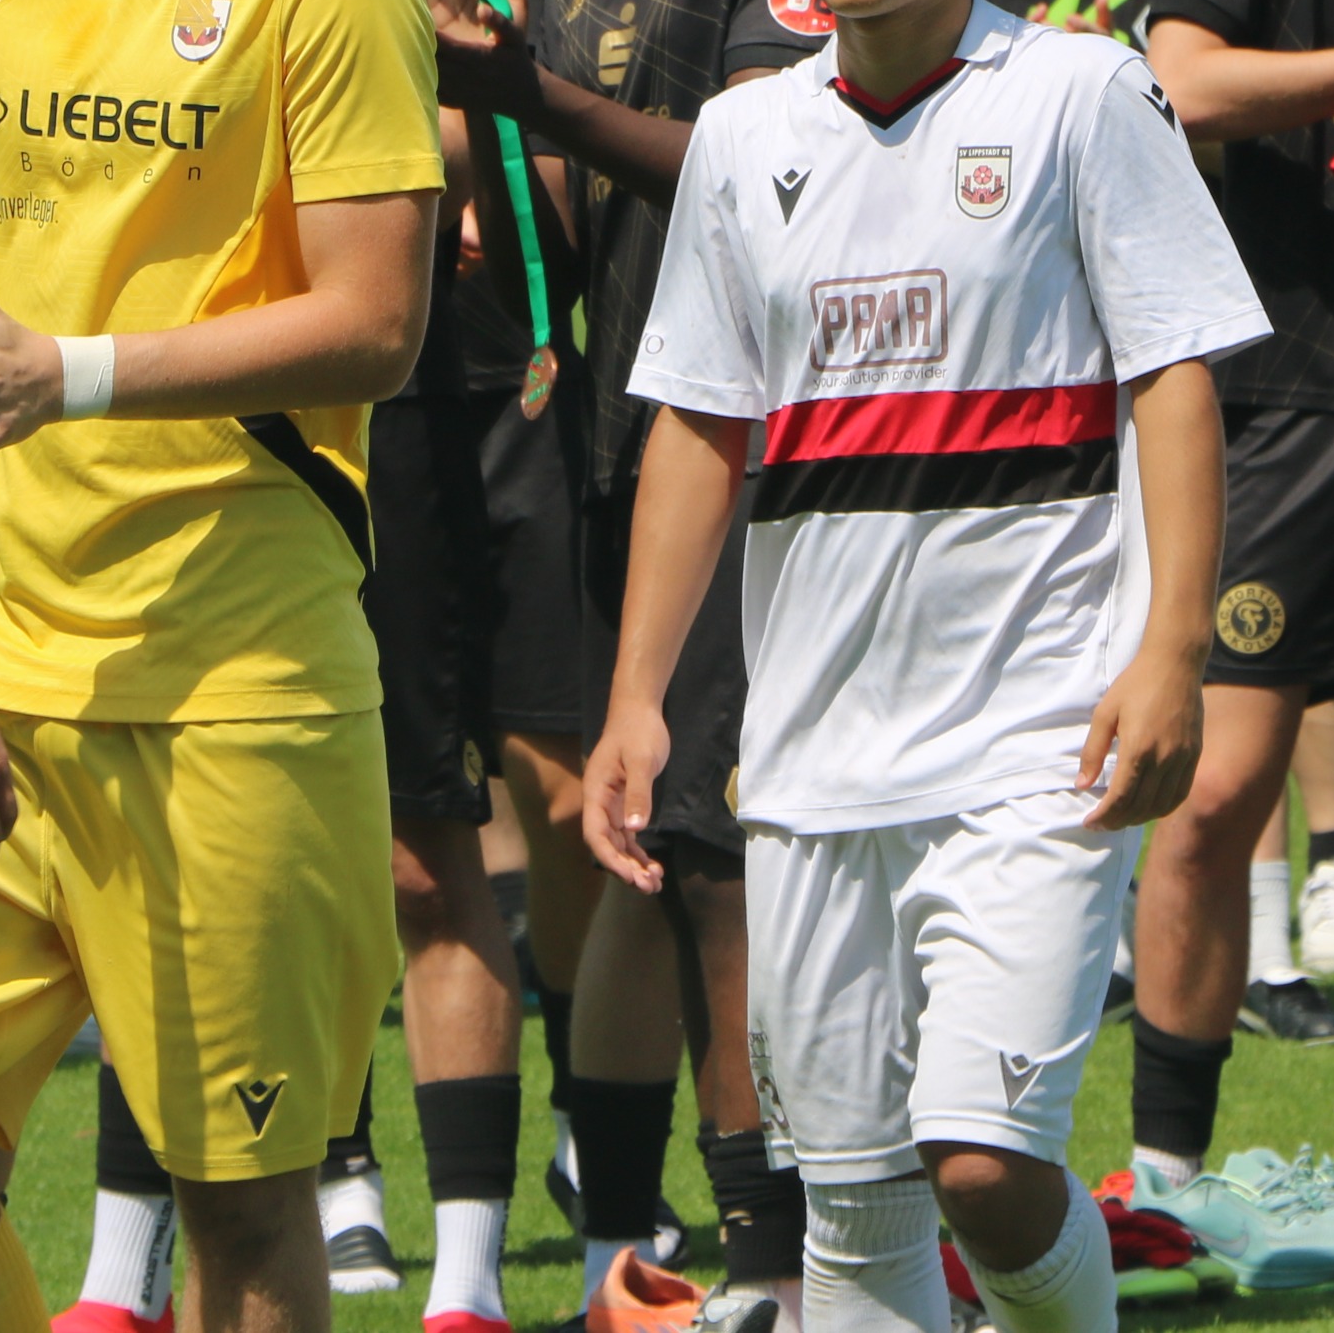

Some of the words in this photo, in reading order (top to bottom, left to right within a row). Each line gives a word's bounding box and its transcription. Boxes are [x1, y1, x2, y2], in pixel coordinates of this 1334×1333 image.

[19, 89, 220, 150] LIEBELT
[968, 148, 1001, 157] LIPPSTADT
[822, 287, 932, 355] PAMA
[892, 366, 949, 384] provider
